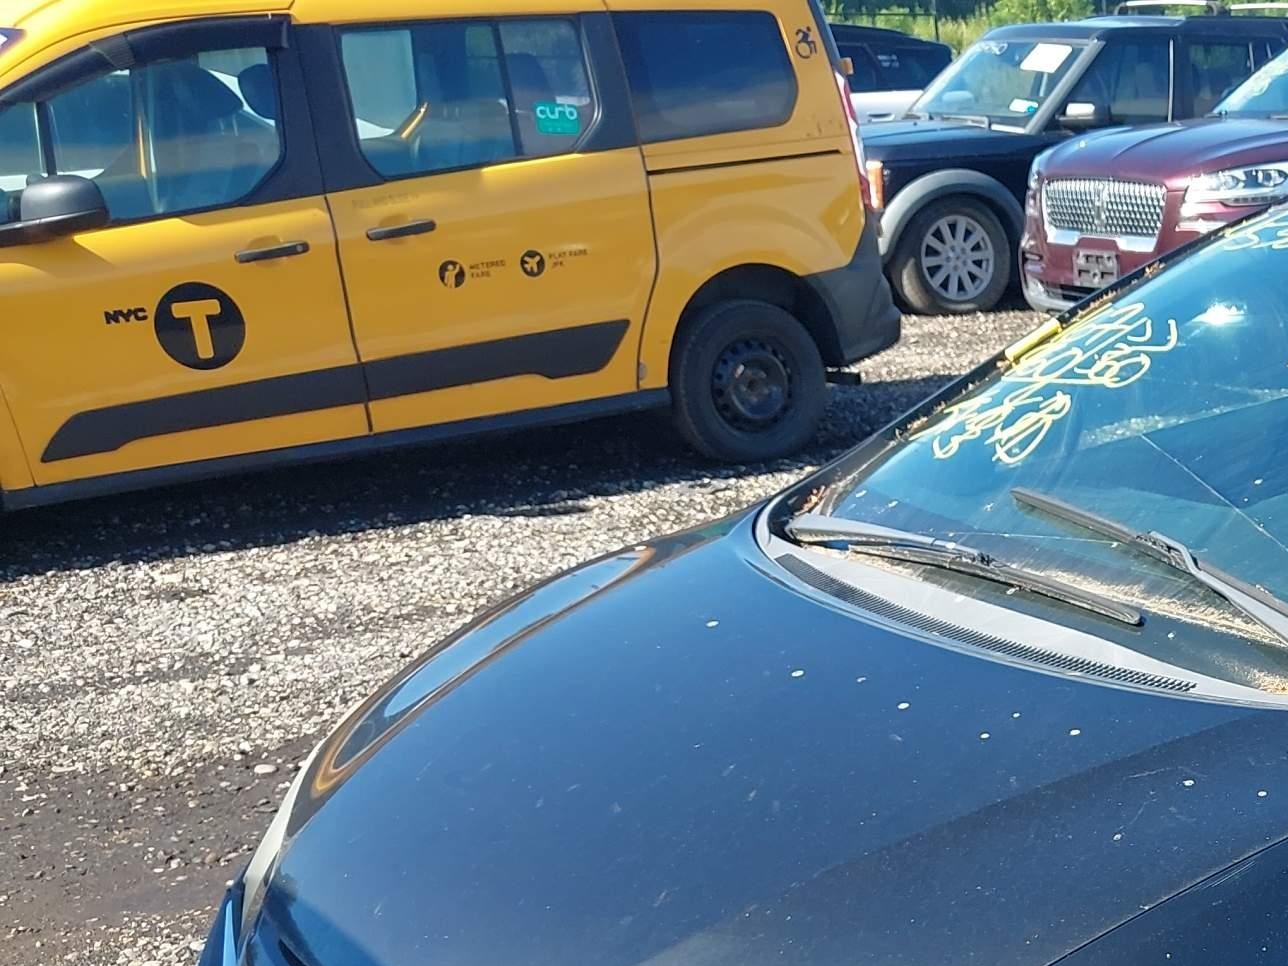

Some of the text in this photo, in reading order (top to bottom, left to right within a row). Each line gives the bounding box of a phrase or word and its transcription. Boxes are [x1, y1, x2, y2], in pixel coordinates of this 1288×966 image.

[535, 103, 578, 121] curb
[103, 298, 221, 360] NYC T
